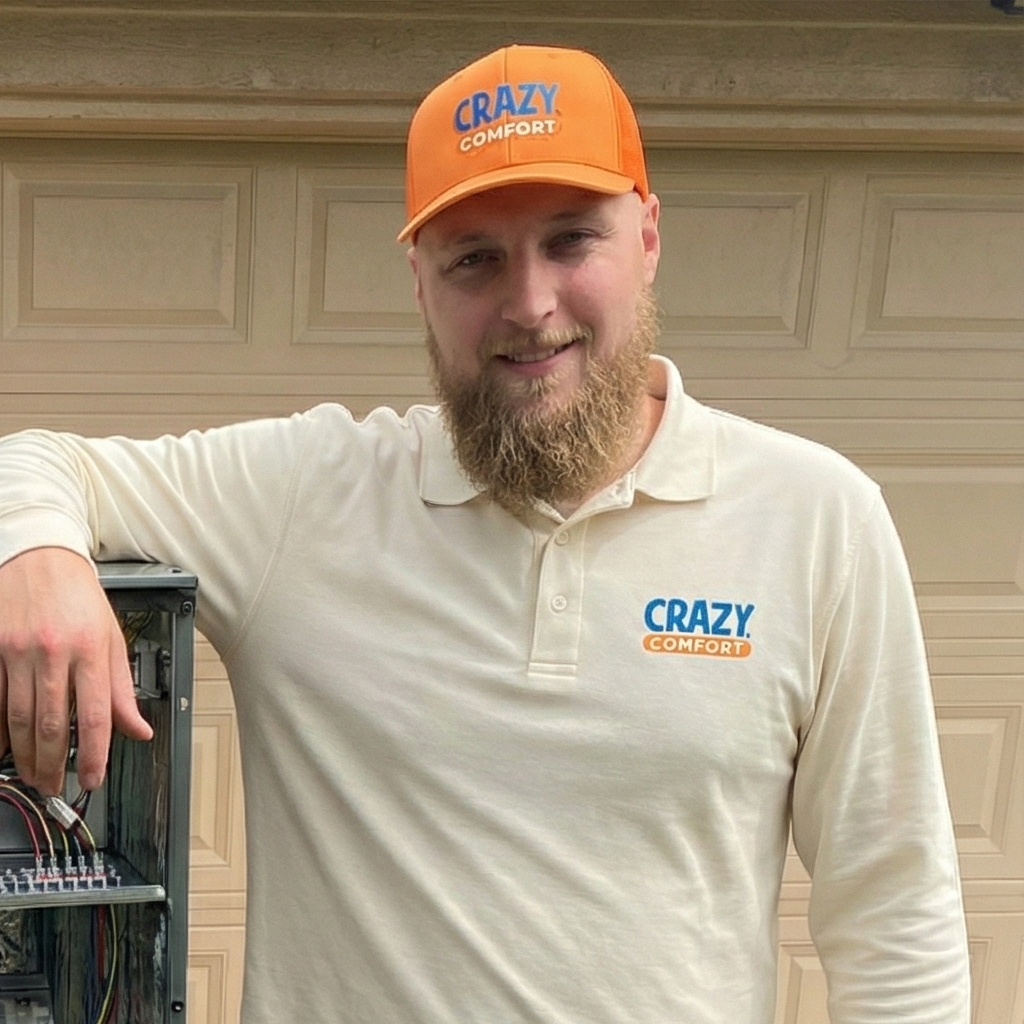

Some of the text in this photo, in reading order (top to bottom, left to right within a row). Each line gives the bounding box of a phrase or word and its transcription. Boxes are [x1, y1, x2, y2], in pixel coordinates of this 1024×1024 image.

[455, 82, 558, 132] CRAZY
[460, 120, 555, 151] COMFORT
[649, 637, 745, 654] COMFORT
